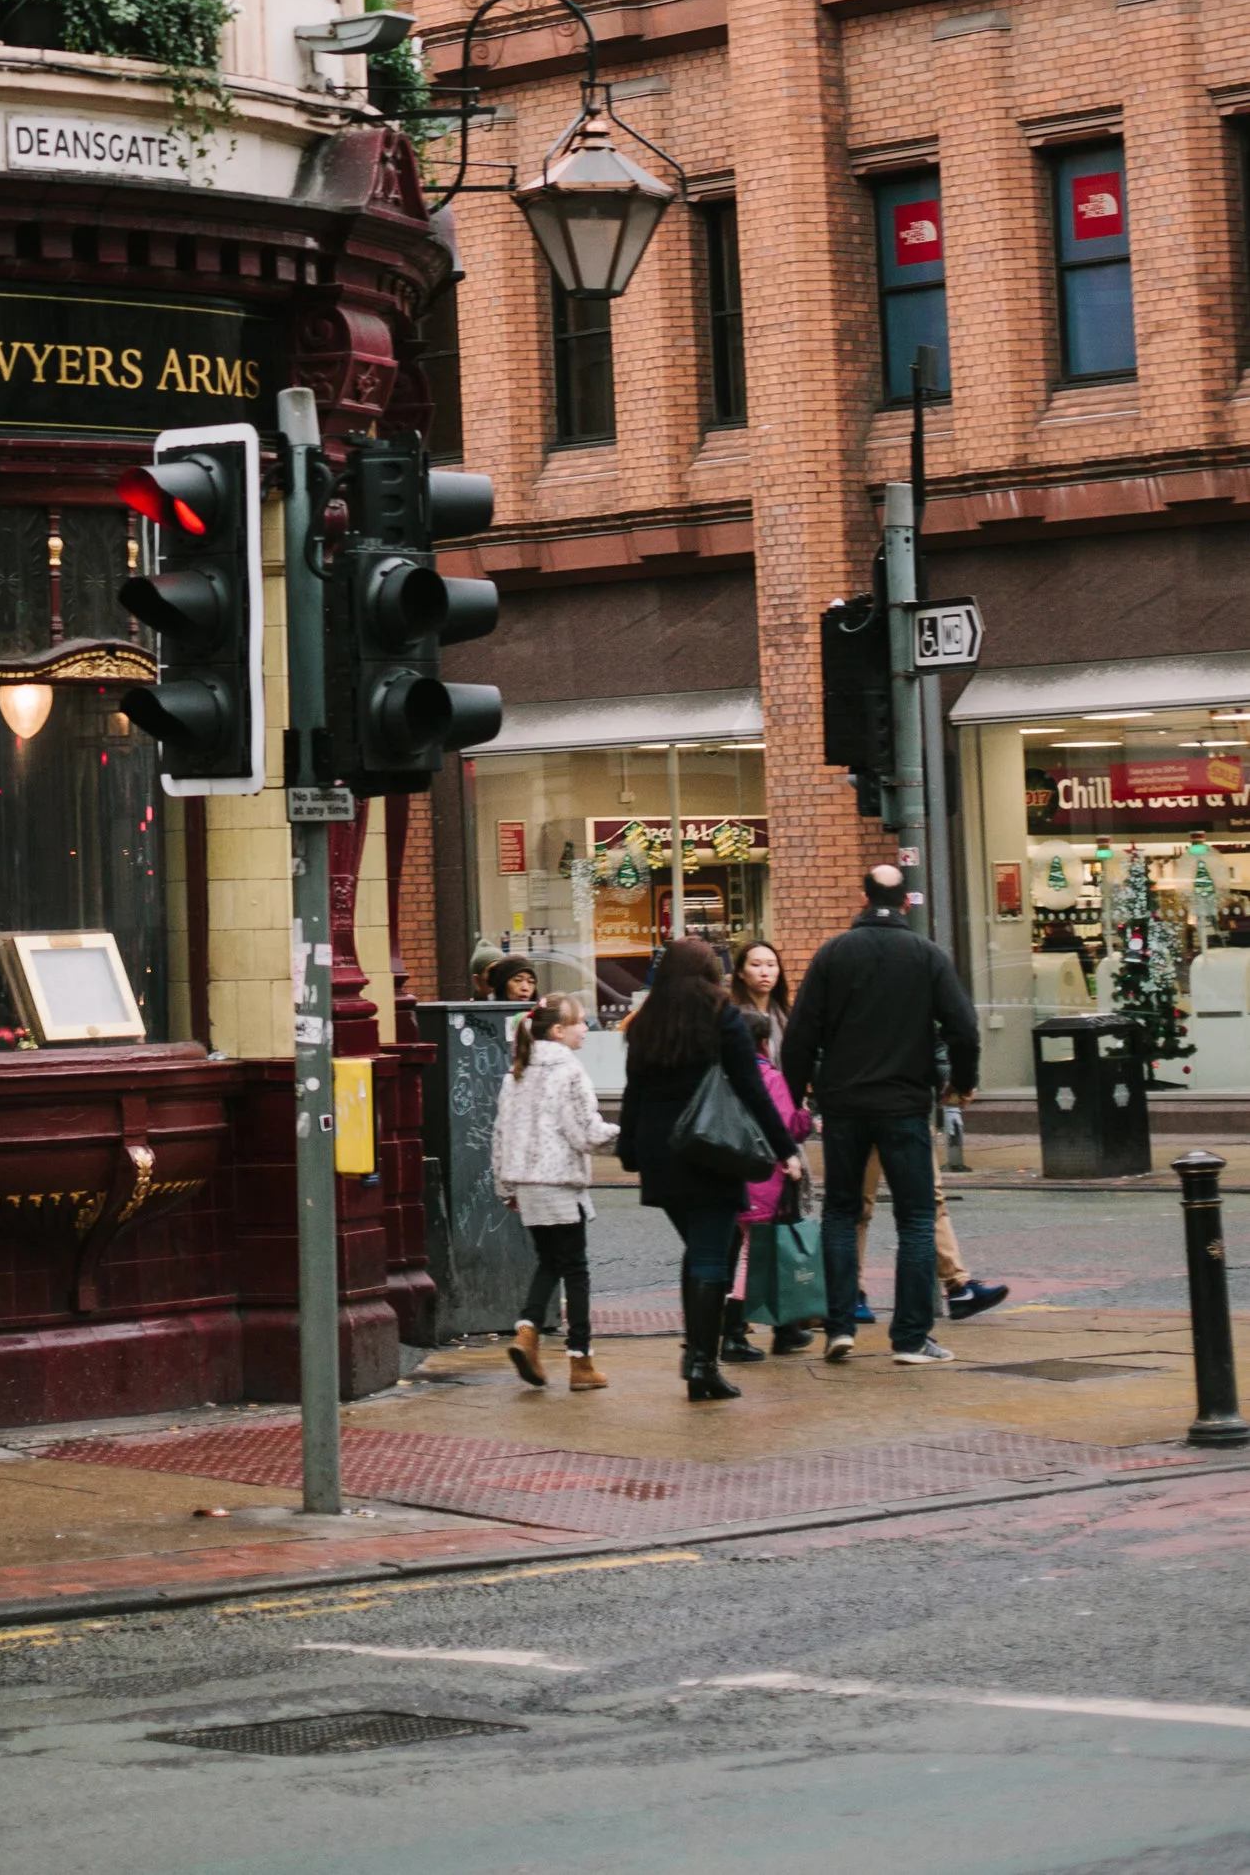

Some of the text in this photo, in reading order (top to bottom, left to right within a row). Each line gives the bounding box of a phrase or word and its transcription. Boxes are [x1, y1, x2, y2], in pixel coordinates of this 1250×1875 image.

[15, 126, 170, 167] DEANSGATE
[156, 348, 261, 399] ARMS
[292, 791, 308, 802] No
[1025, 790, 1054, 807] 017
[306, 806, 324, 817] any
